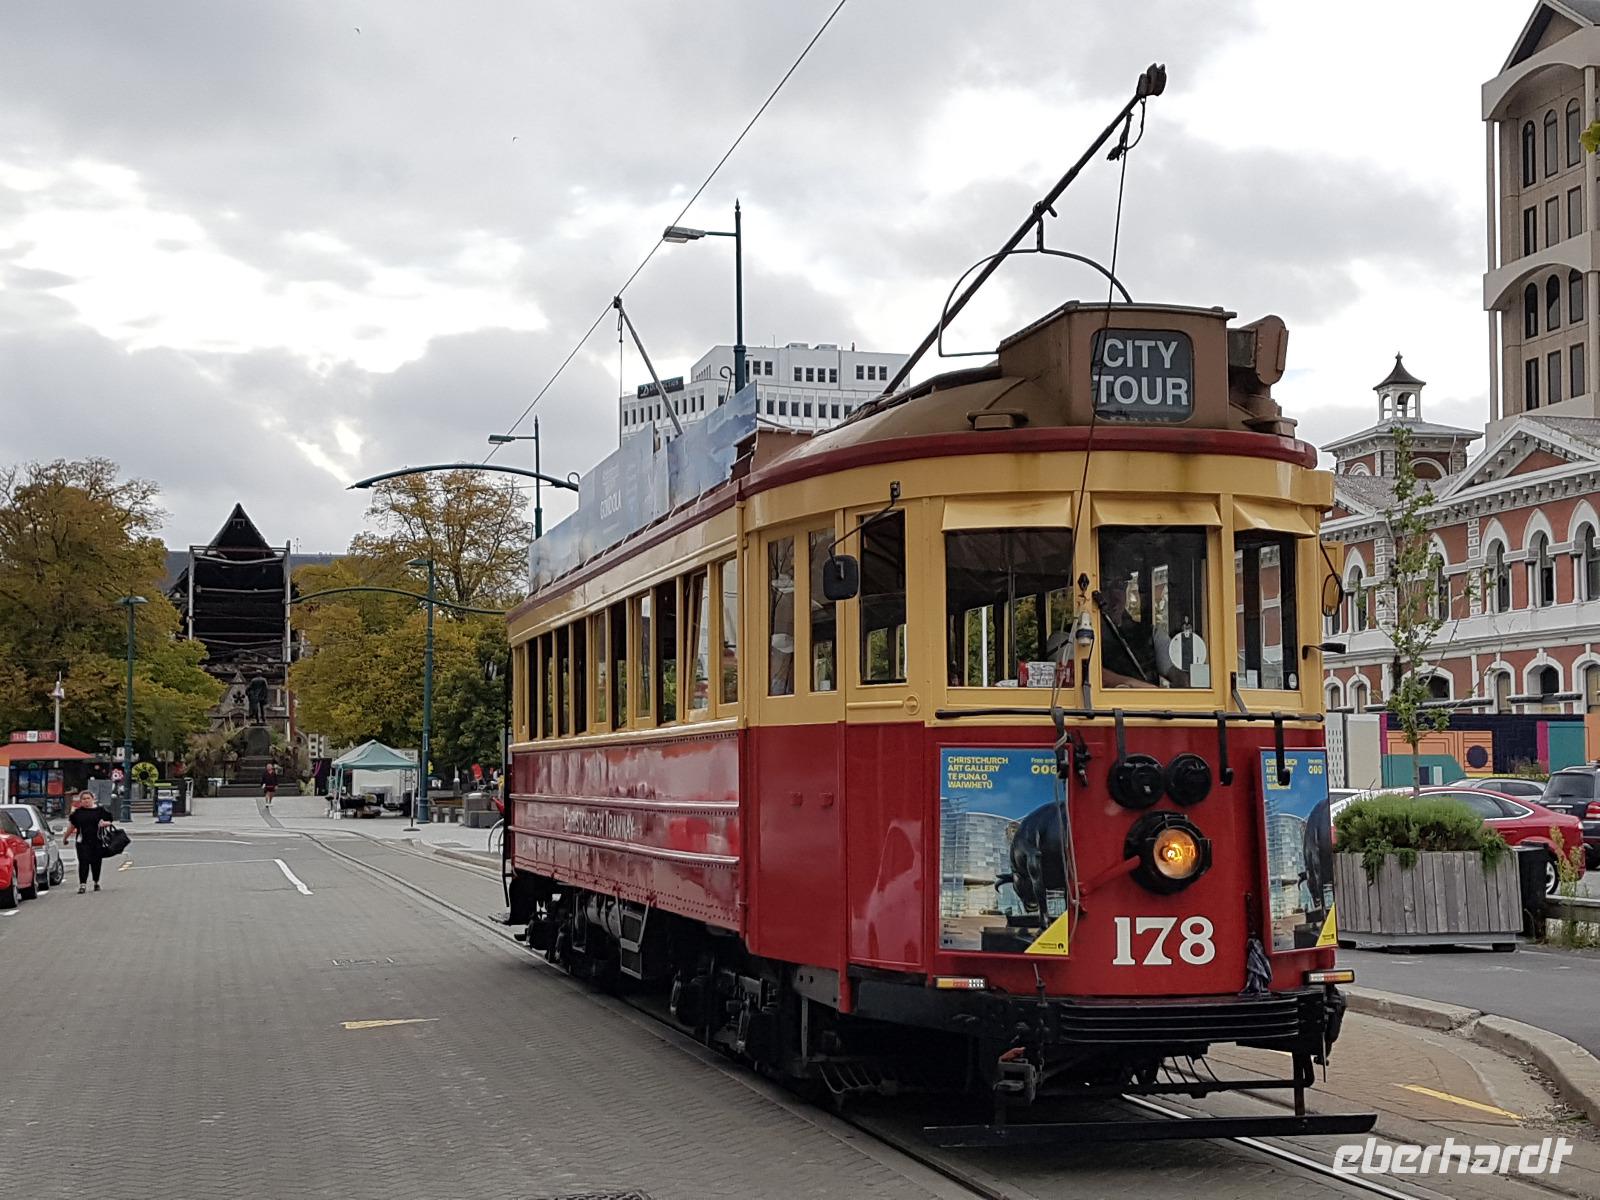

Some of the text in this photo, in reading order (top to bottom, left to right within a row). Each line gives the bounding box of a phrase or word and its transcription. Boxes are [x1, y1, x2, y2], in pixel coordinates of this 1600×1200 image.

[1103, 338, 1178, 369] CITY
[1093, 375, 1188, 406] TOUR
[947, 756, 1009, 764] CHRISTCHURCH
[947, 764, 1000, 772] ART GALLERY
[1112, 916, 1216, 965] 178
